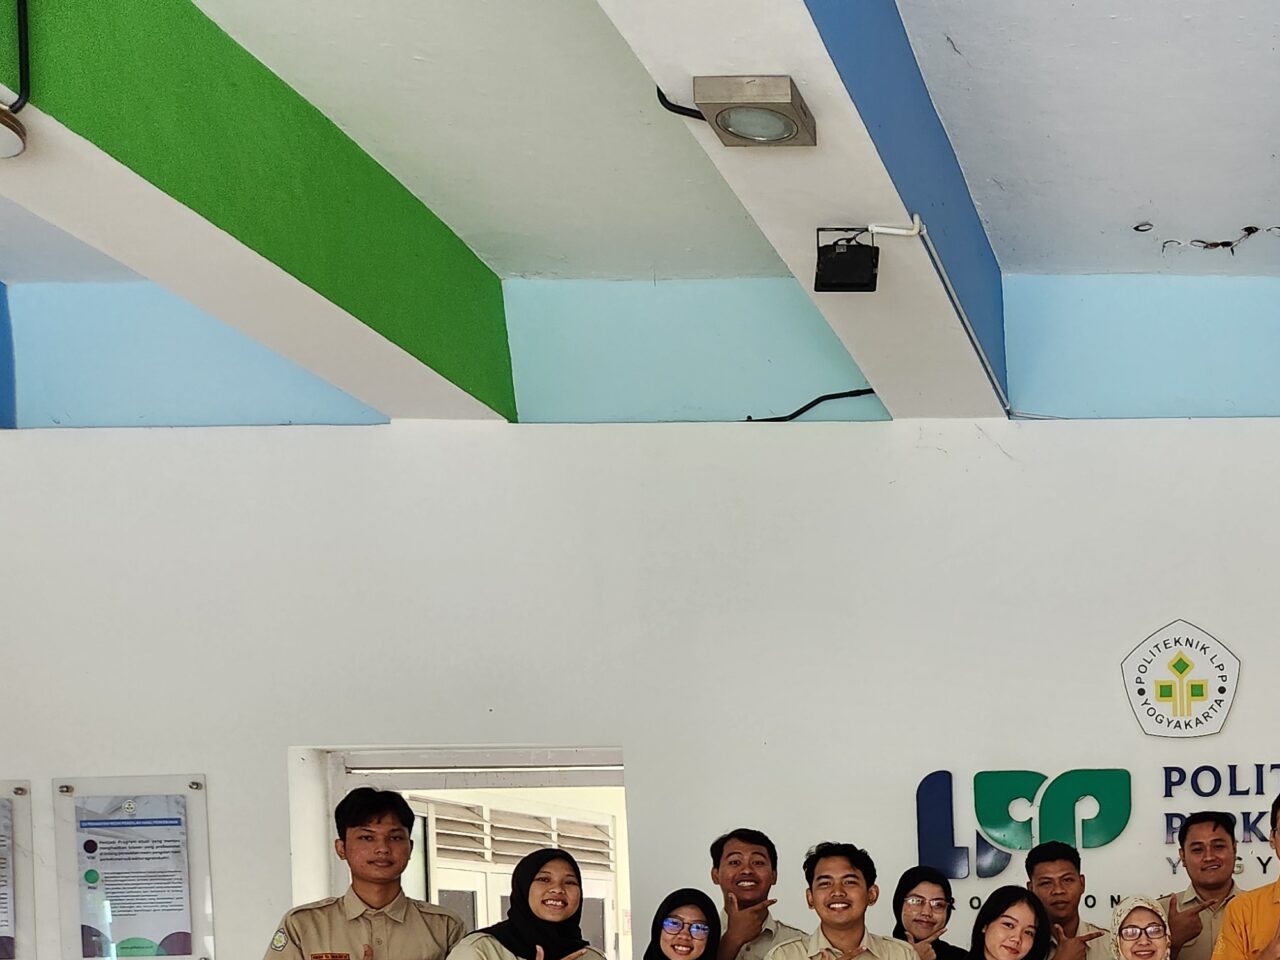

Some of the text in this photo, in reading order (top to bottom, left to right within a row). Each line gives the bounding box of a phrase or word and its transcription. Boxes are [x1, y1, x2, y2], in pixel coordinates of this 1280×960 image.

[1135, 636, 1228, 685] POLITEKNIK LPP
[1140, 697, 1225, 730] YOGYAKARTA
